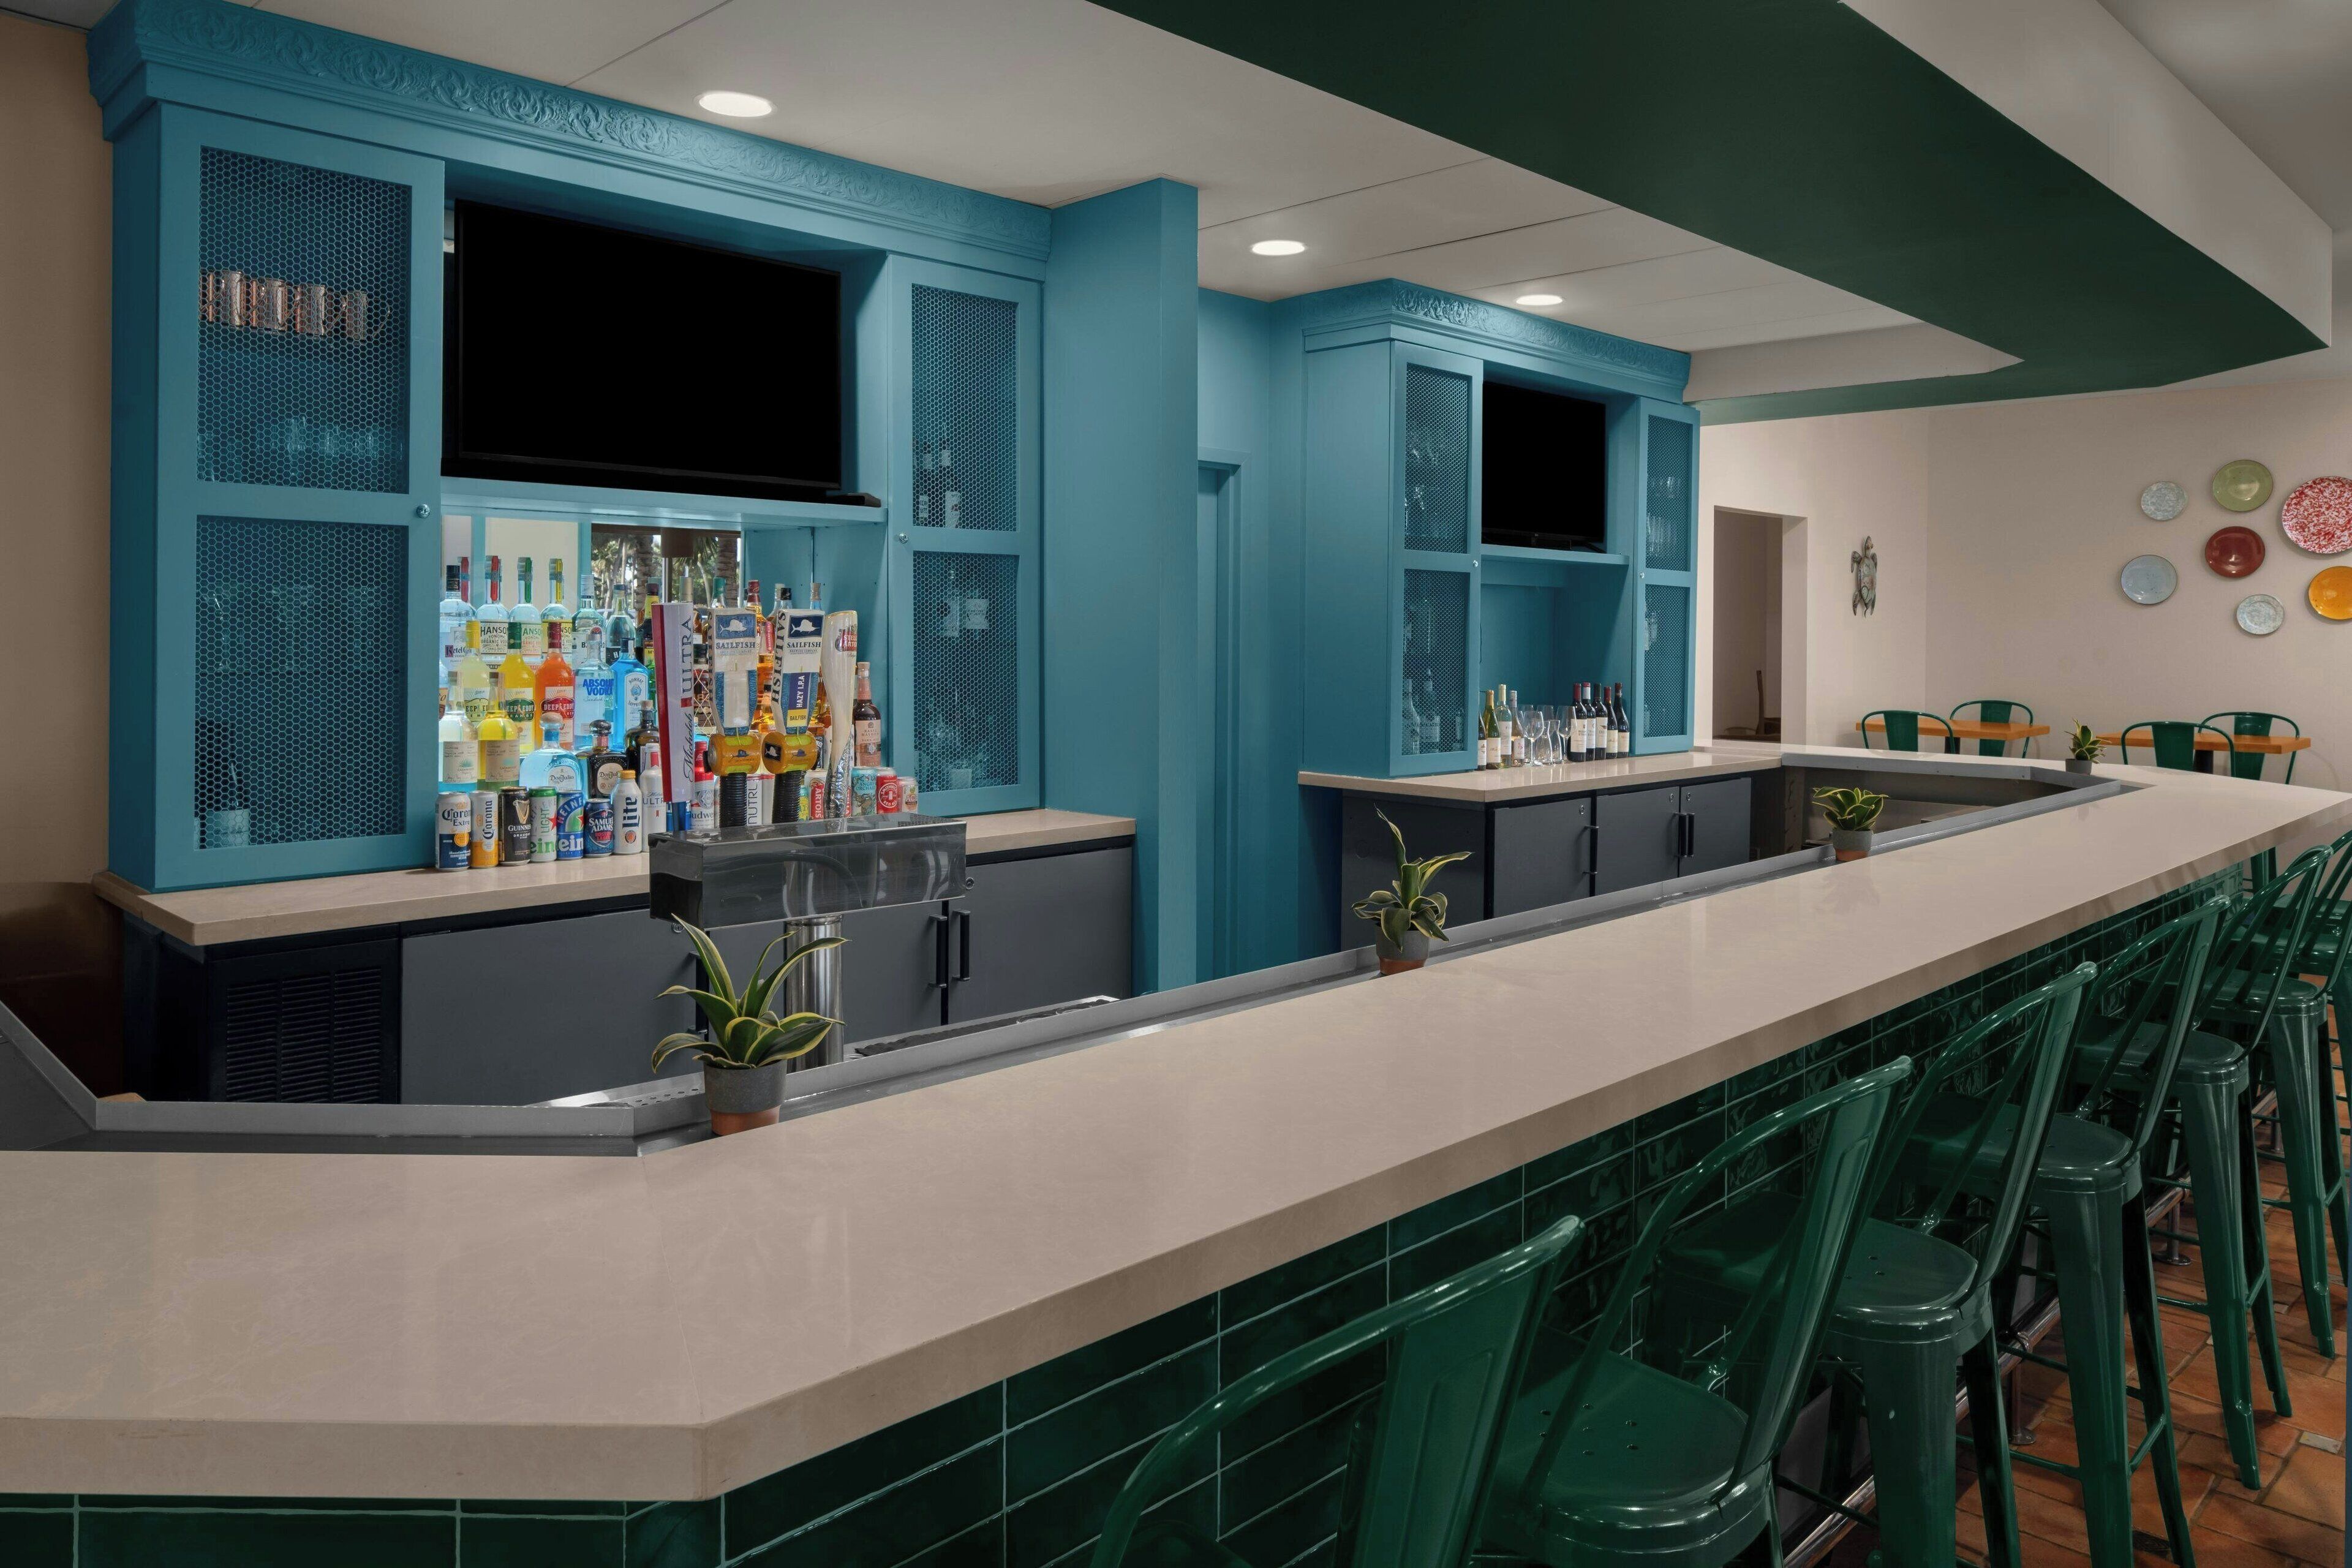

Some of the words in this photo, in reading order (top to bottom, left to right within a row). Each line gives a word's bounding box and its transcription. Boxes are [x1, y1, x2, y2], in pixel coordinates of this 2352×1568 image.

[480, 626, 507, 637] HANSO
[522, 628, 540, 636] ANSO
[681, 616, 692, 693] ULTRA
[772, 611, 786, 705] SAILFISH
[683, 711, 693, 783] Michelob
[559, 774, 574, 783] Julio
[442, 809, 471, 822] Coron
[483, 801, 495, 840] Corona
[540, 809, 550, 834] LIGHT
[557, 797, 582, 824] HEINE
[622, 797, 640, 829] Lite
[591, 824, 613, 832] ADAMS
